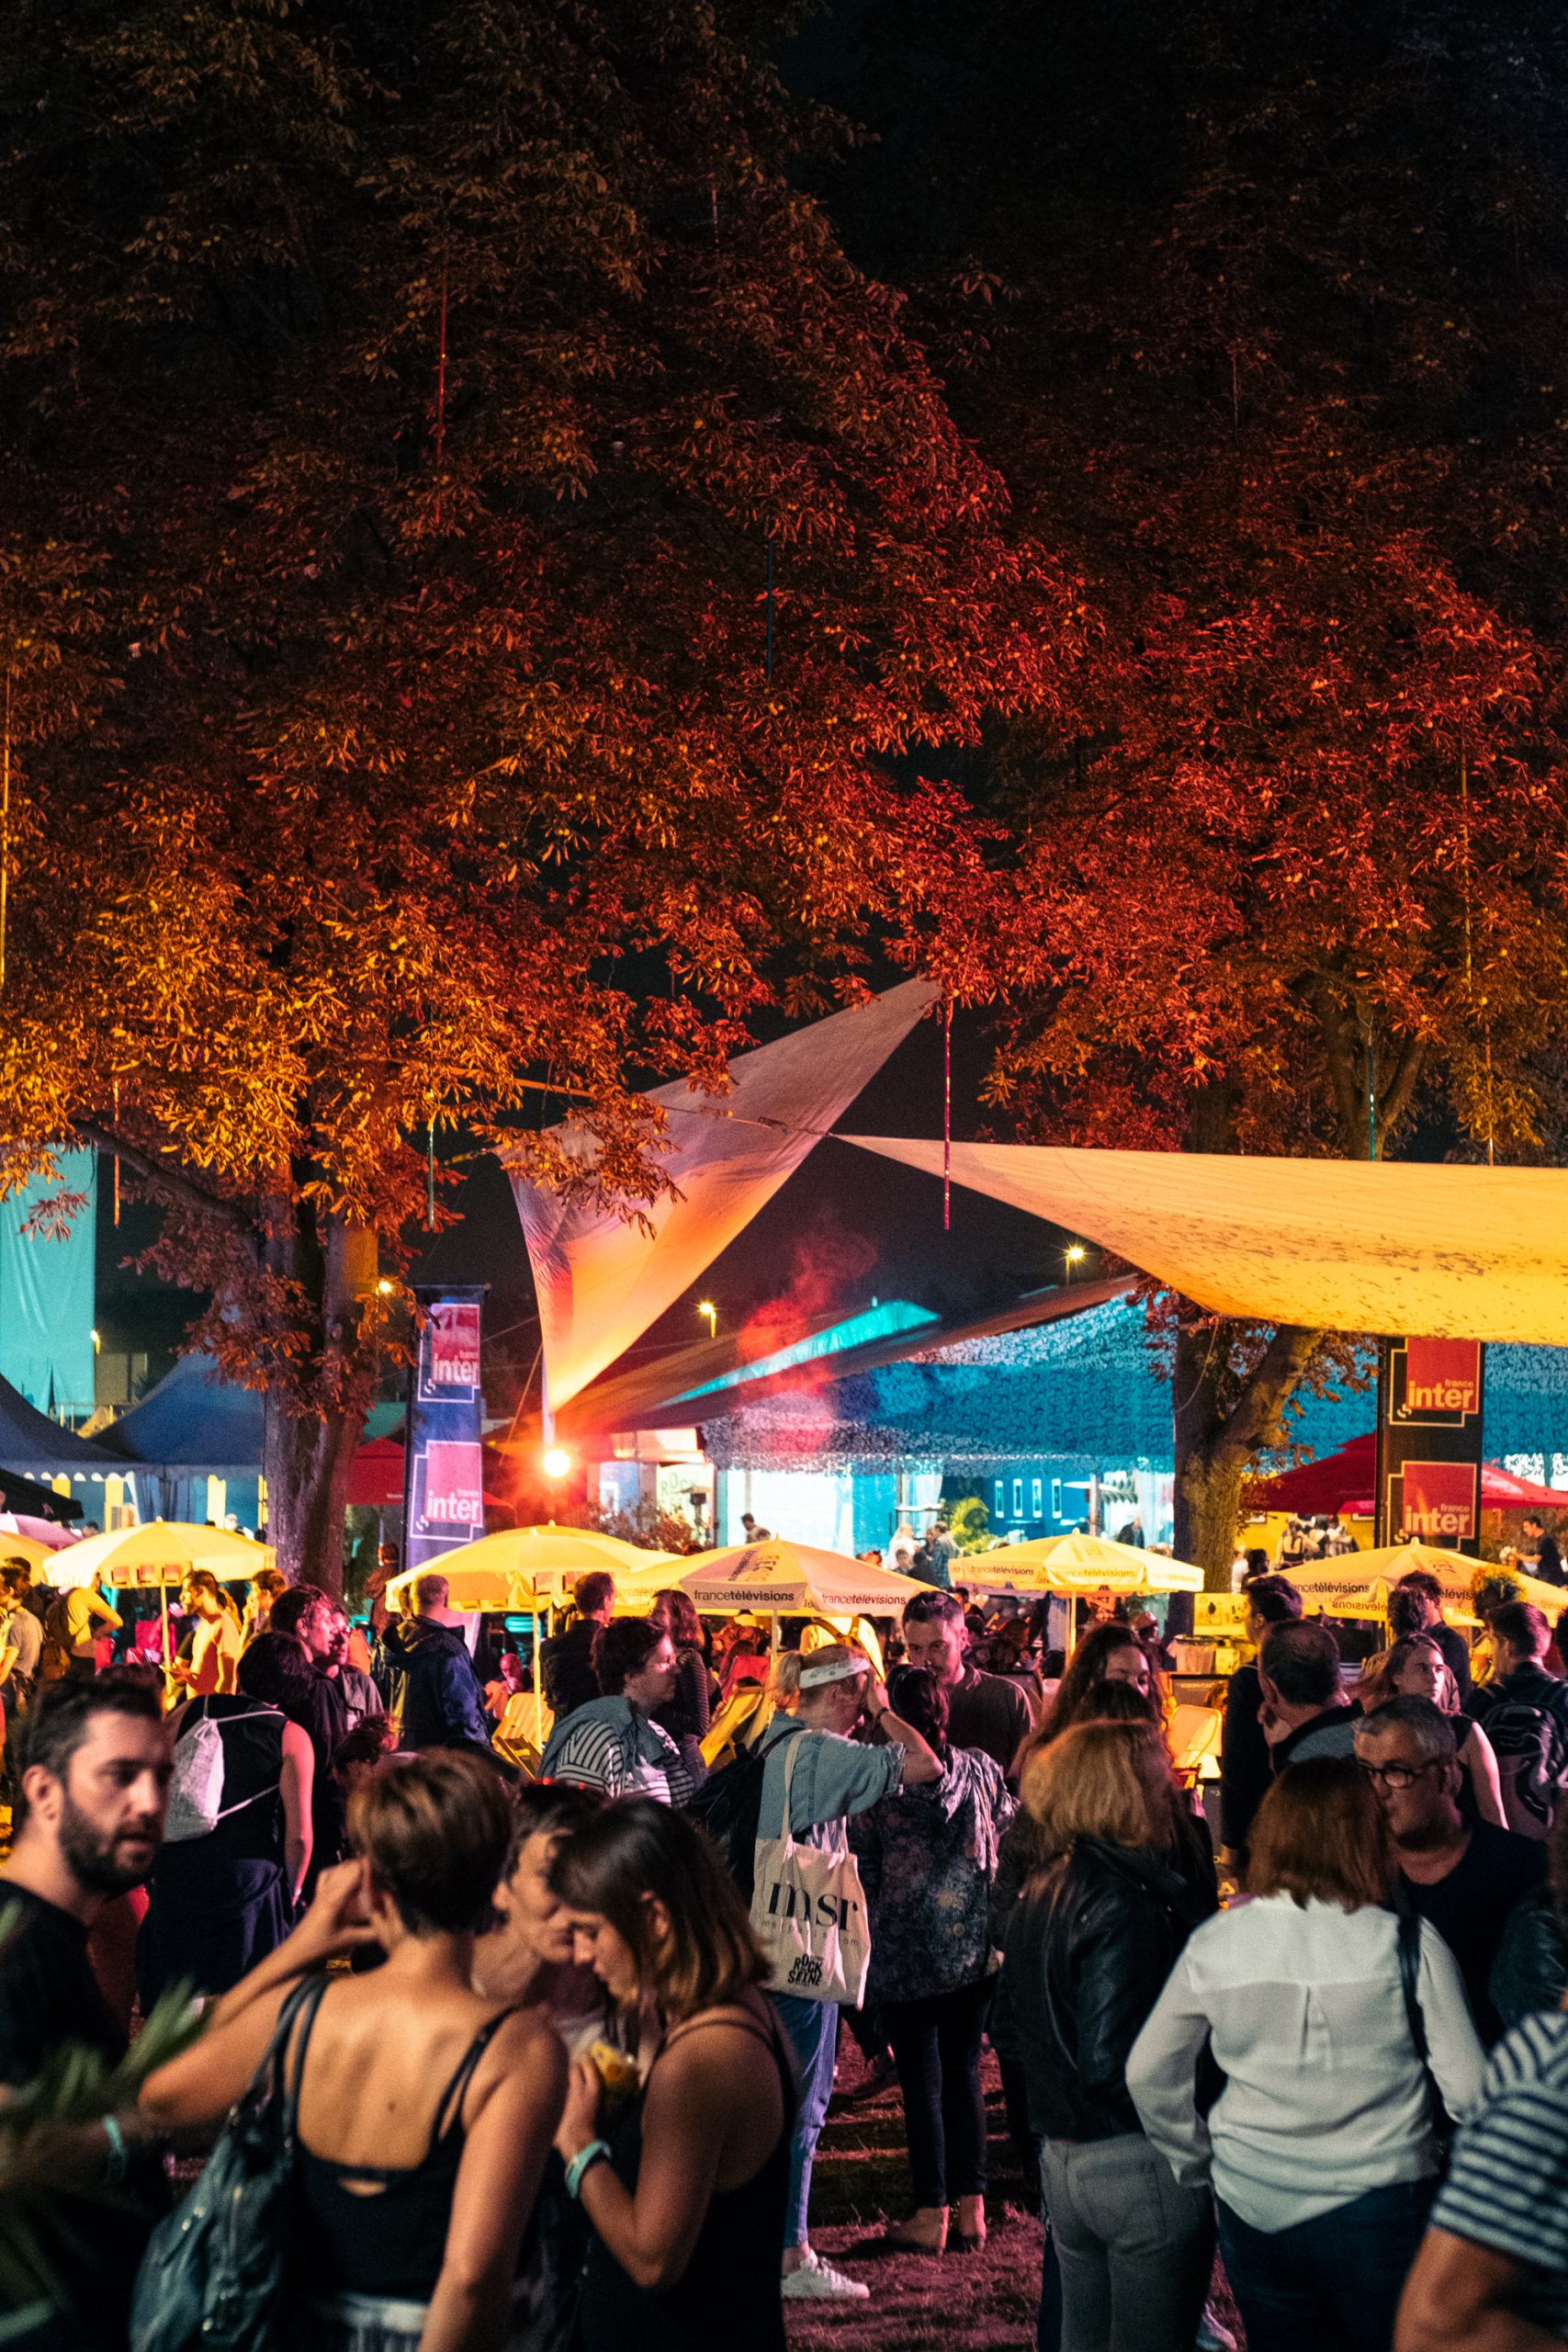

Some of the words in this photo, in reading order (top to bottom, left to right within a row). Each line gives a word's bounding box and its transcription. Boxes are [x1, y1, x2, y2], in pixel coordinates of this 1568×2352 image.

[433, 1353, 478, 1383] inter
[1408, 1380, 1473, 1408] inter
[1445, 1379, 1474, 1388] france
[426, 1490, 479, 1521] inter
[1440, 1503, 1470, 1513] france
[1405, 1505, 1470, 1533] inter
[694, 1589, 795, 1601] francetélévisions
[769, 1881, 859, 1931] msr
[788, 1970, 822, 1986] SEINE
[794, 1953, 824, 1977] ROCK
